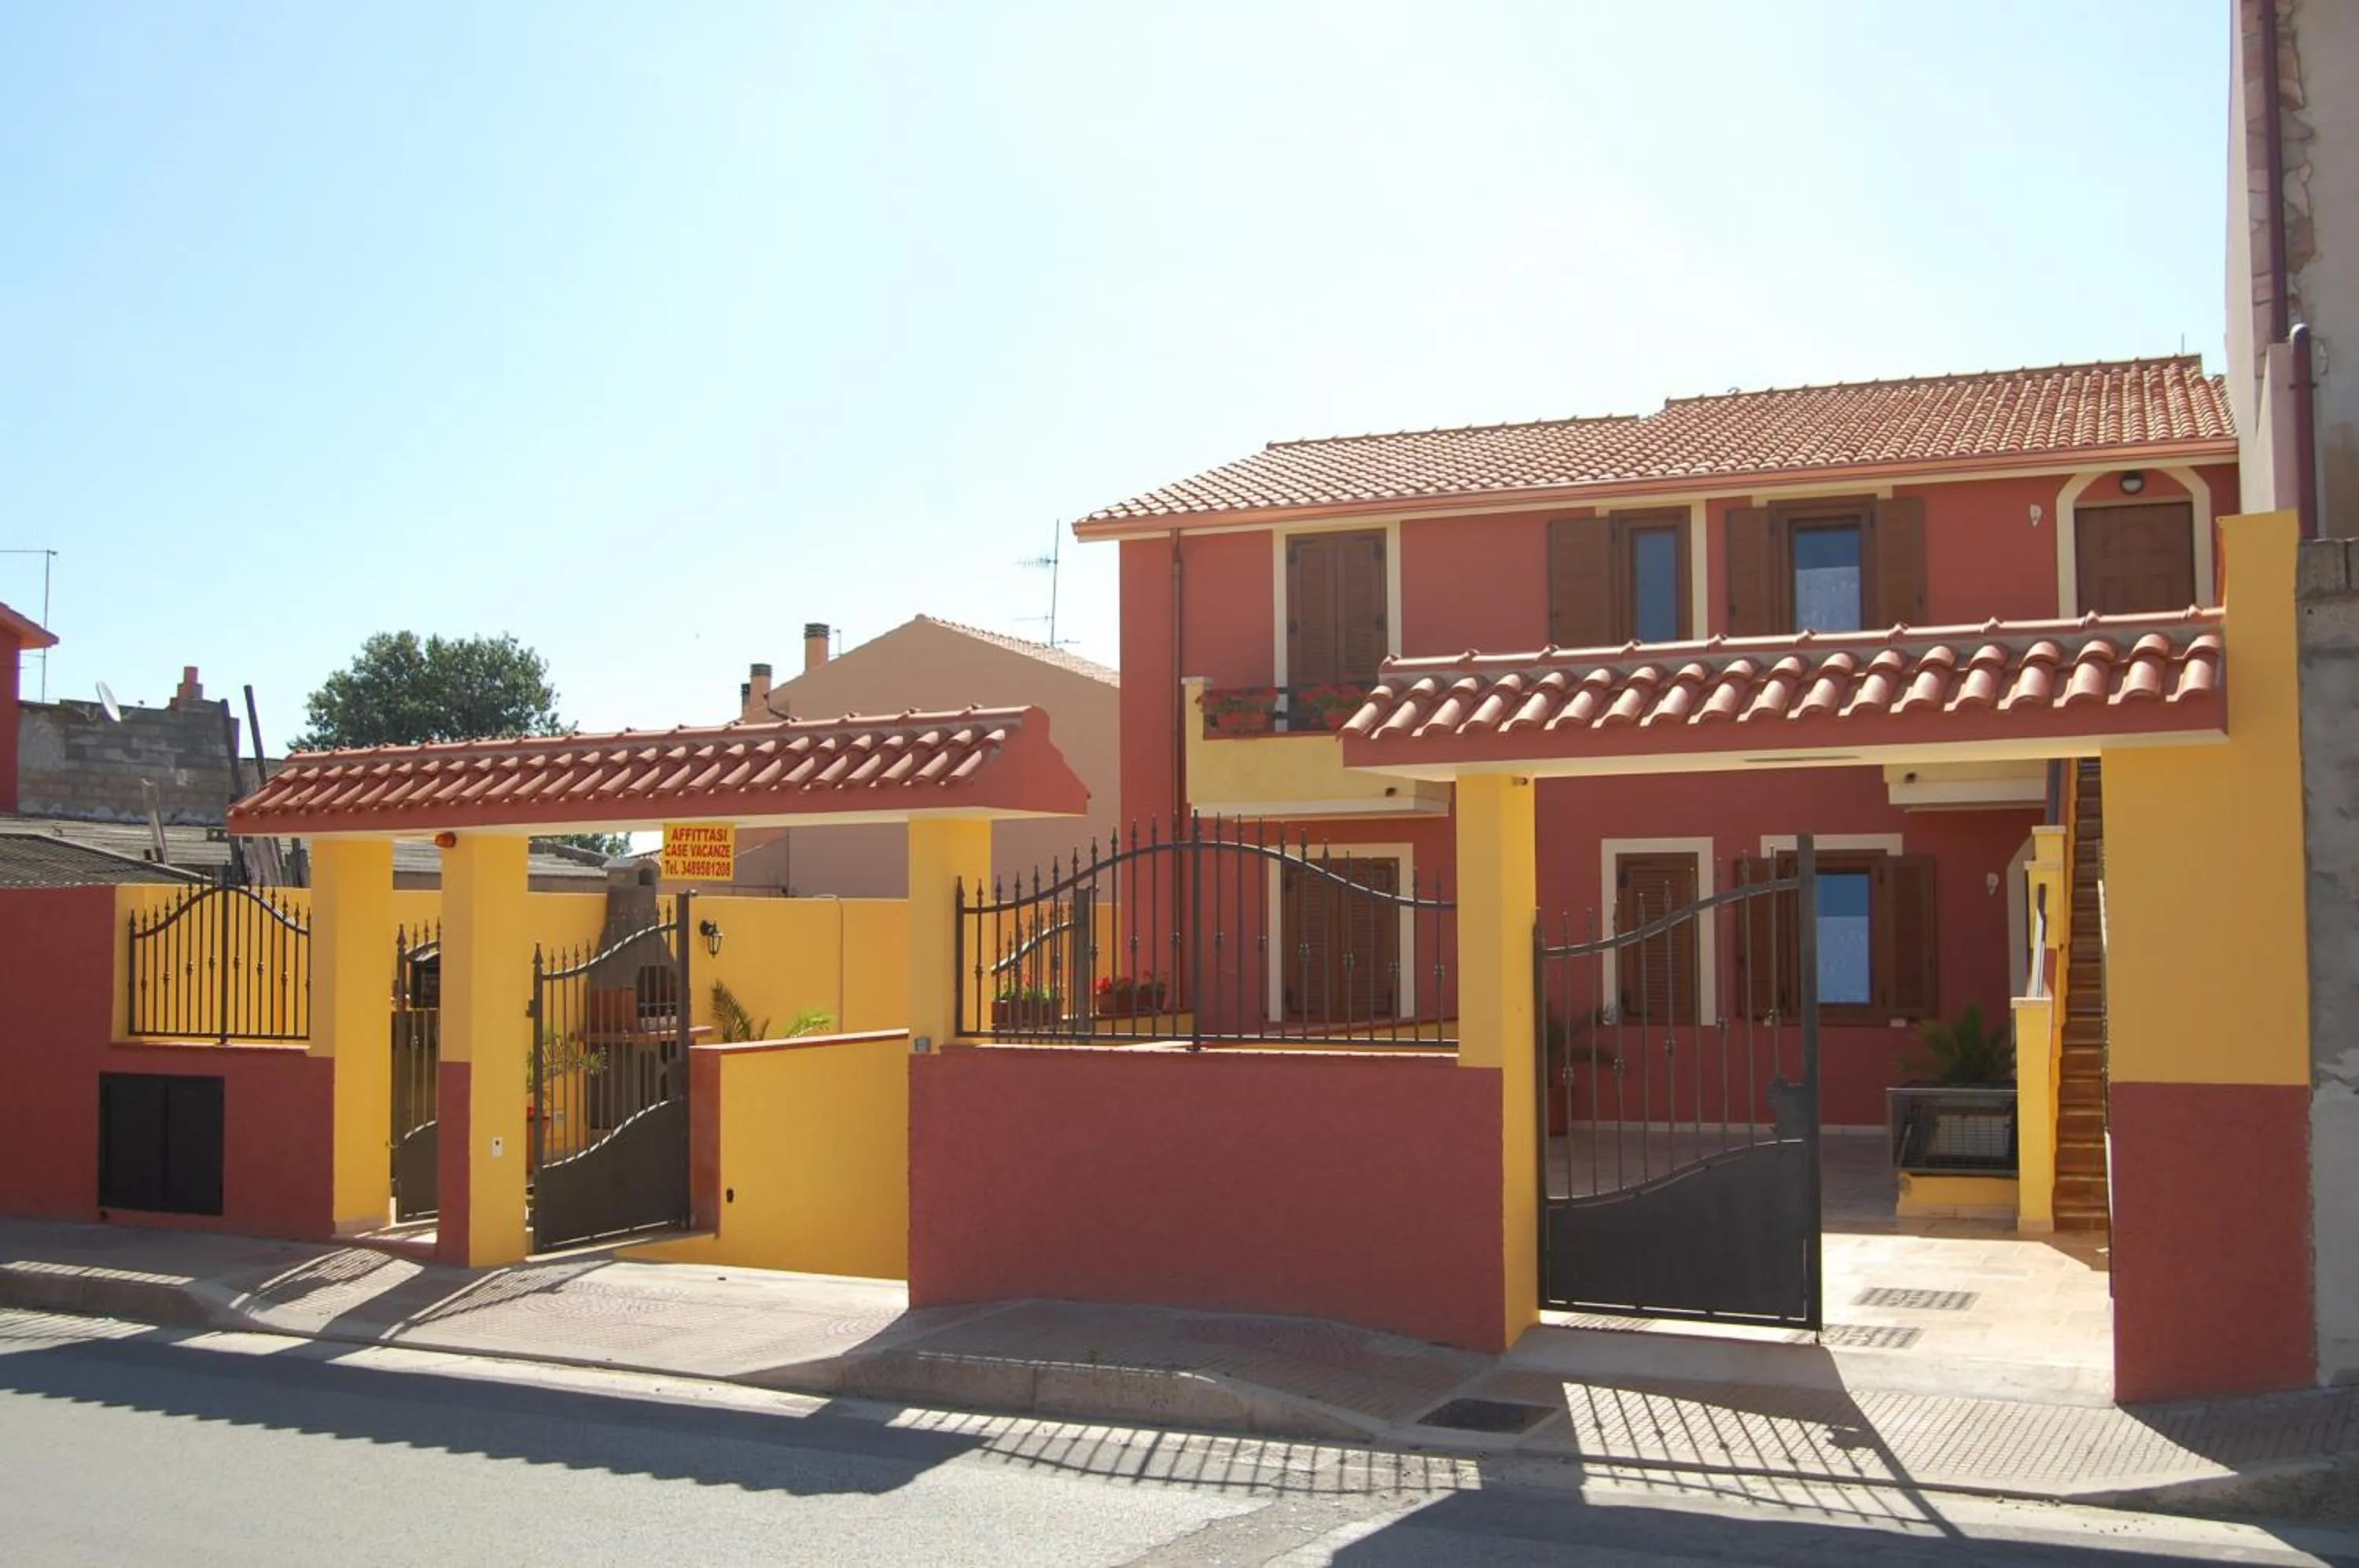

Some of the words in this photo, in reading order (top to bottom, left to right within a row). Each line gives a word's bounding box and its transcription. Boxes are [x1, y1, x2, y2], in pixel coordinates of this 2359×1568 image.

[672, 827, 727, 841] AFFITTASI
[664, 844, 688, 857] CASE
[690, 844, 731, 858] VACANZE
